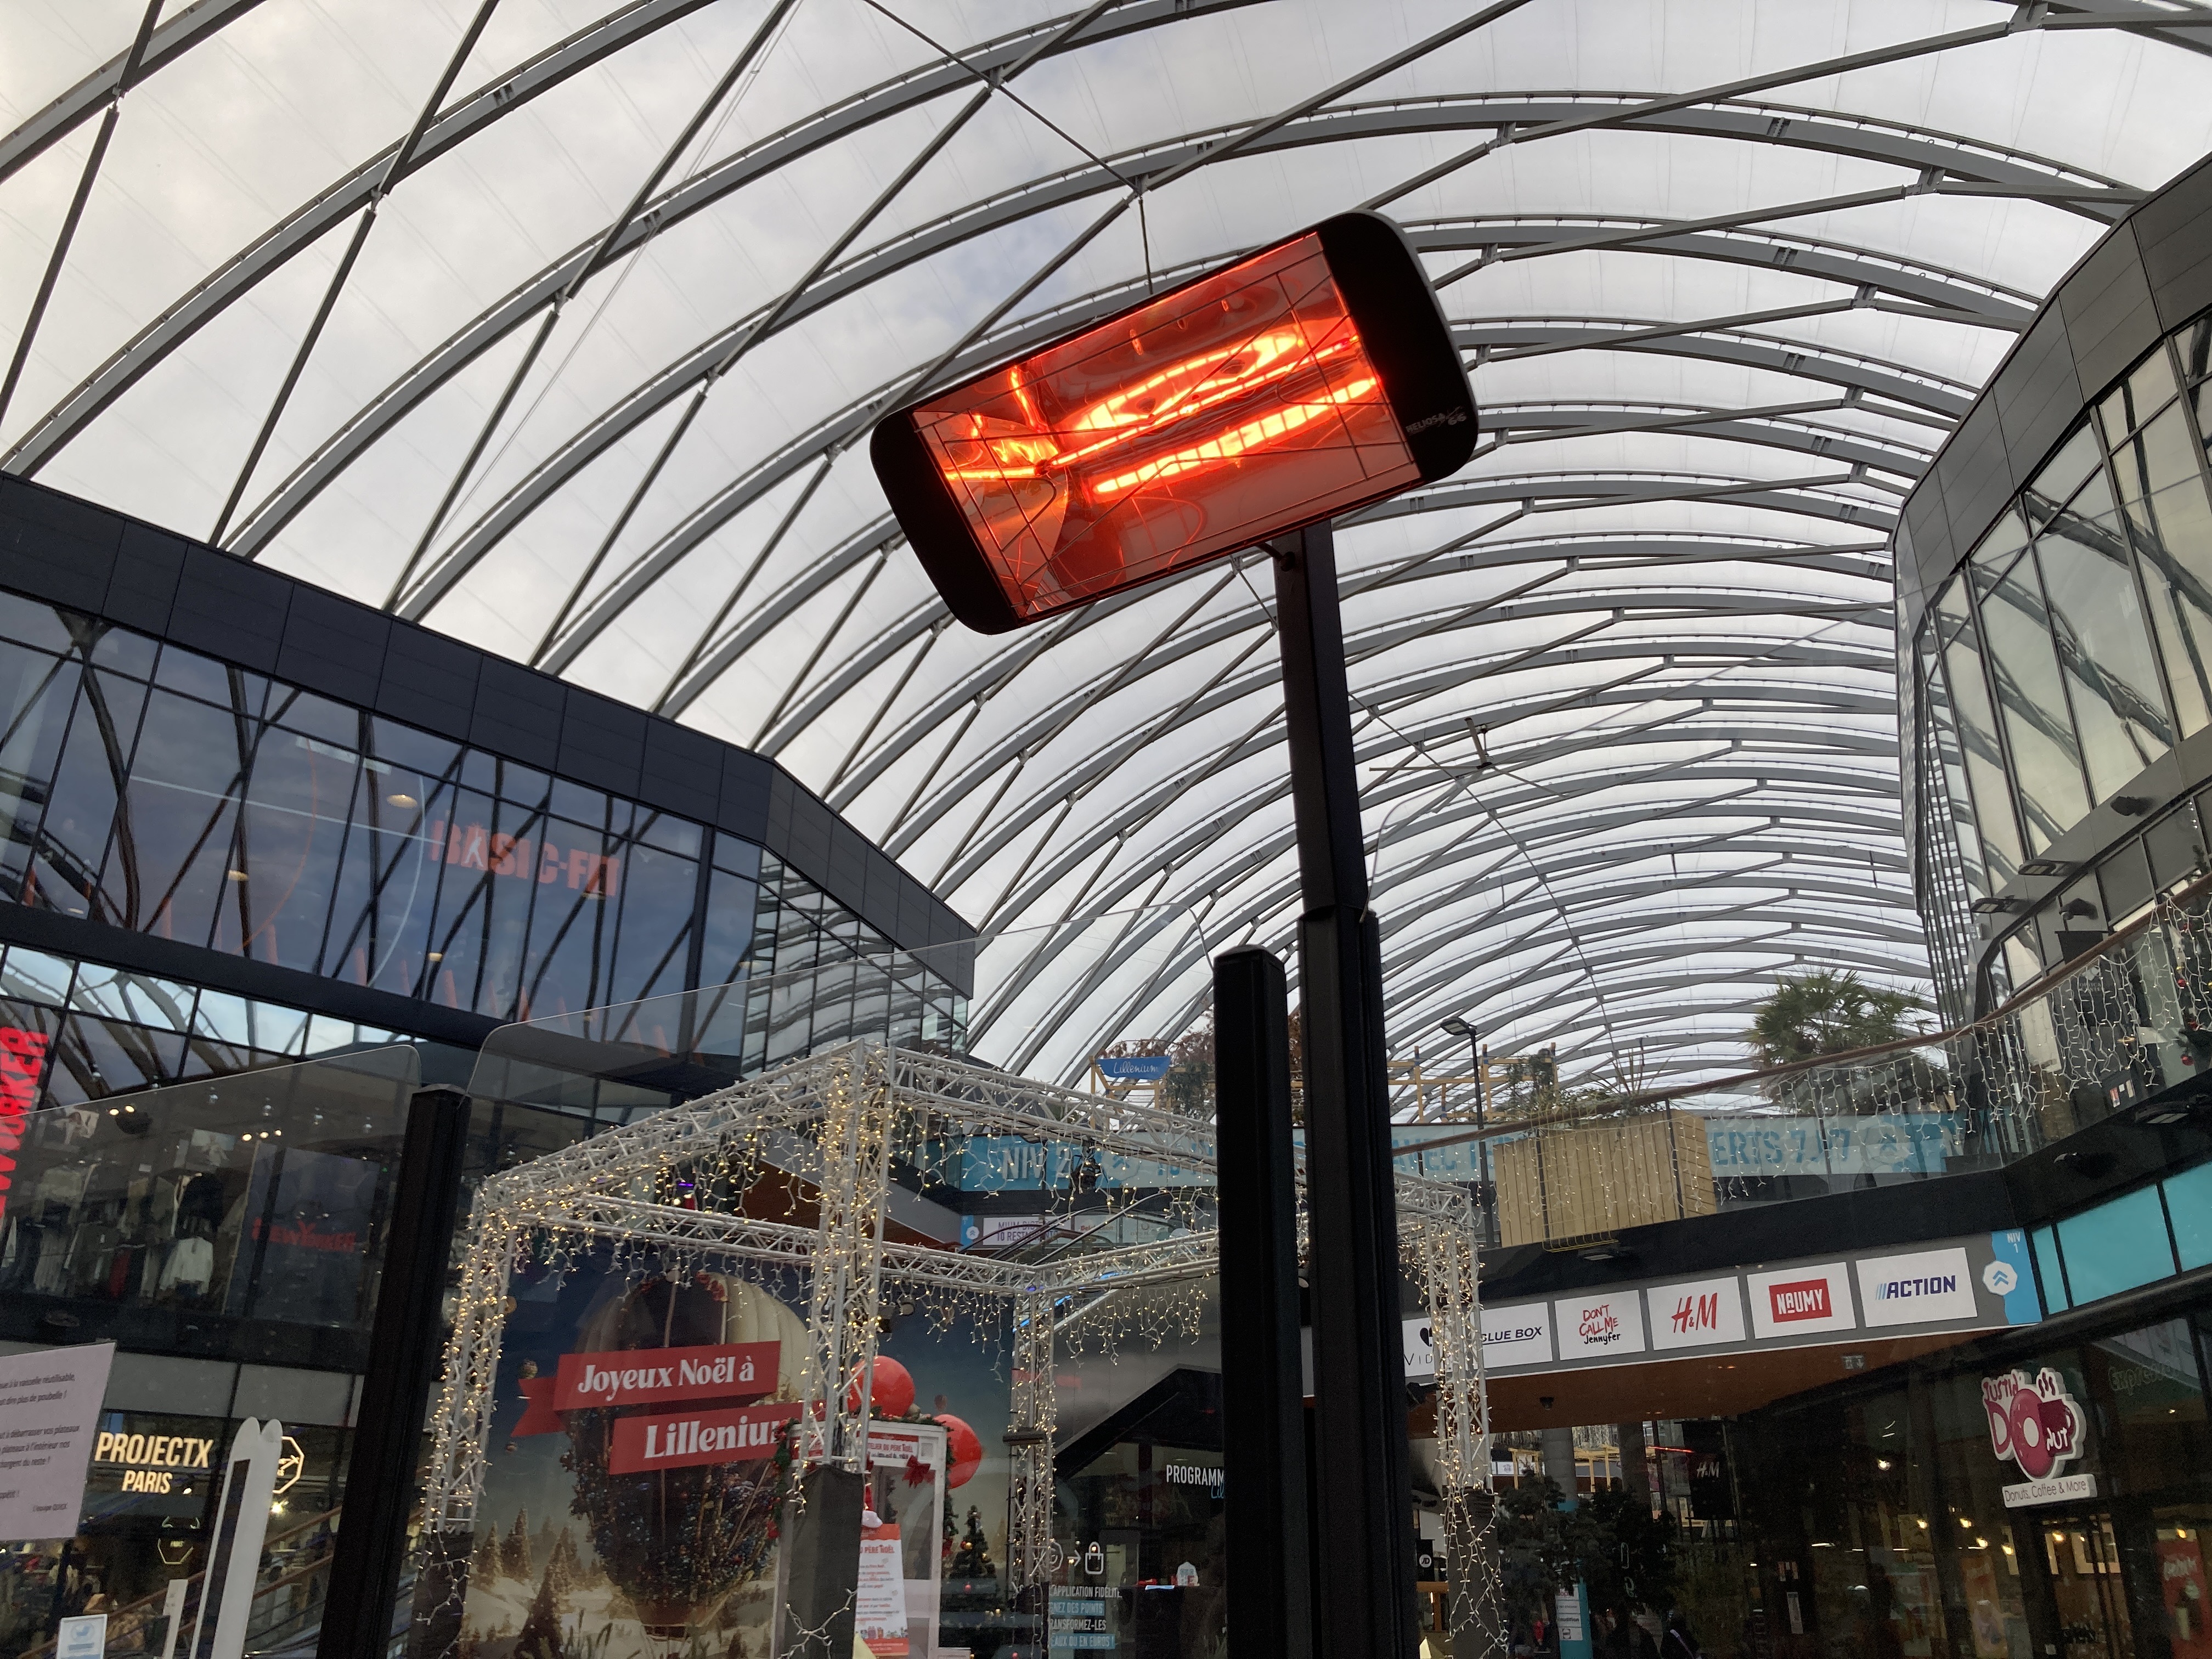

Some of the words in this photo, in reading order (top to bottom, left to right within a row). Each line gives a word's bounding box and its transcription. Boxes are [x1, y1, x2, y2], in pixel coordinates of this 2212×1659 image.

[430, 820, 620, 896] BASIC-FIT
[1113, 1061, 1159, 1074] Lillenium
[1002, 1147, 1043, 1179] NIV
[2007, 1232, 2021, 1243] NIV
[2013, 1243, 2019, 1253] 1
[1886, 1275, 1956, 1299] ACTION
[1776, 1289, 1823, 1314] NAUMY
[1583, 1305, 1609, 1322] DON'T
[1672, 1293, 1717, 1333] H&M
[1515, 1327, 1542, 1338] BOX
[1579, 1321, 1605, 1336] CALL
[1605, 1317, 1618, 1333] ME
[1584, 1332, 1621, 1345] Jennyfer
[578, 1364, 674, 1402] Joyeux
[679, 1356, 736, 1386] Noël
[740, 1356, 754, 1381] à
[94, 1431, 214, 1468] PROJECTX
[122, 1470, 173, 1494] PARIS
[2032, 1483, 2057, 1498] Coffee
[2058, 1482, 2065, 1493] &
[2066, 1480, 2087, 1492] More
